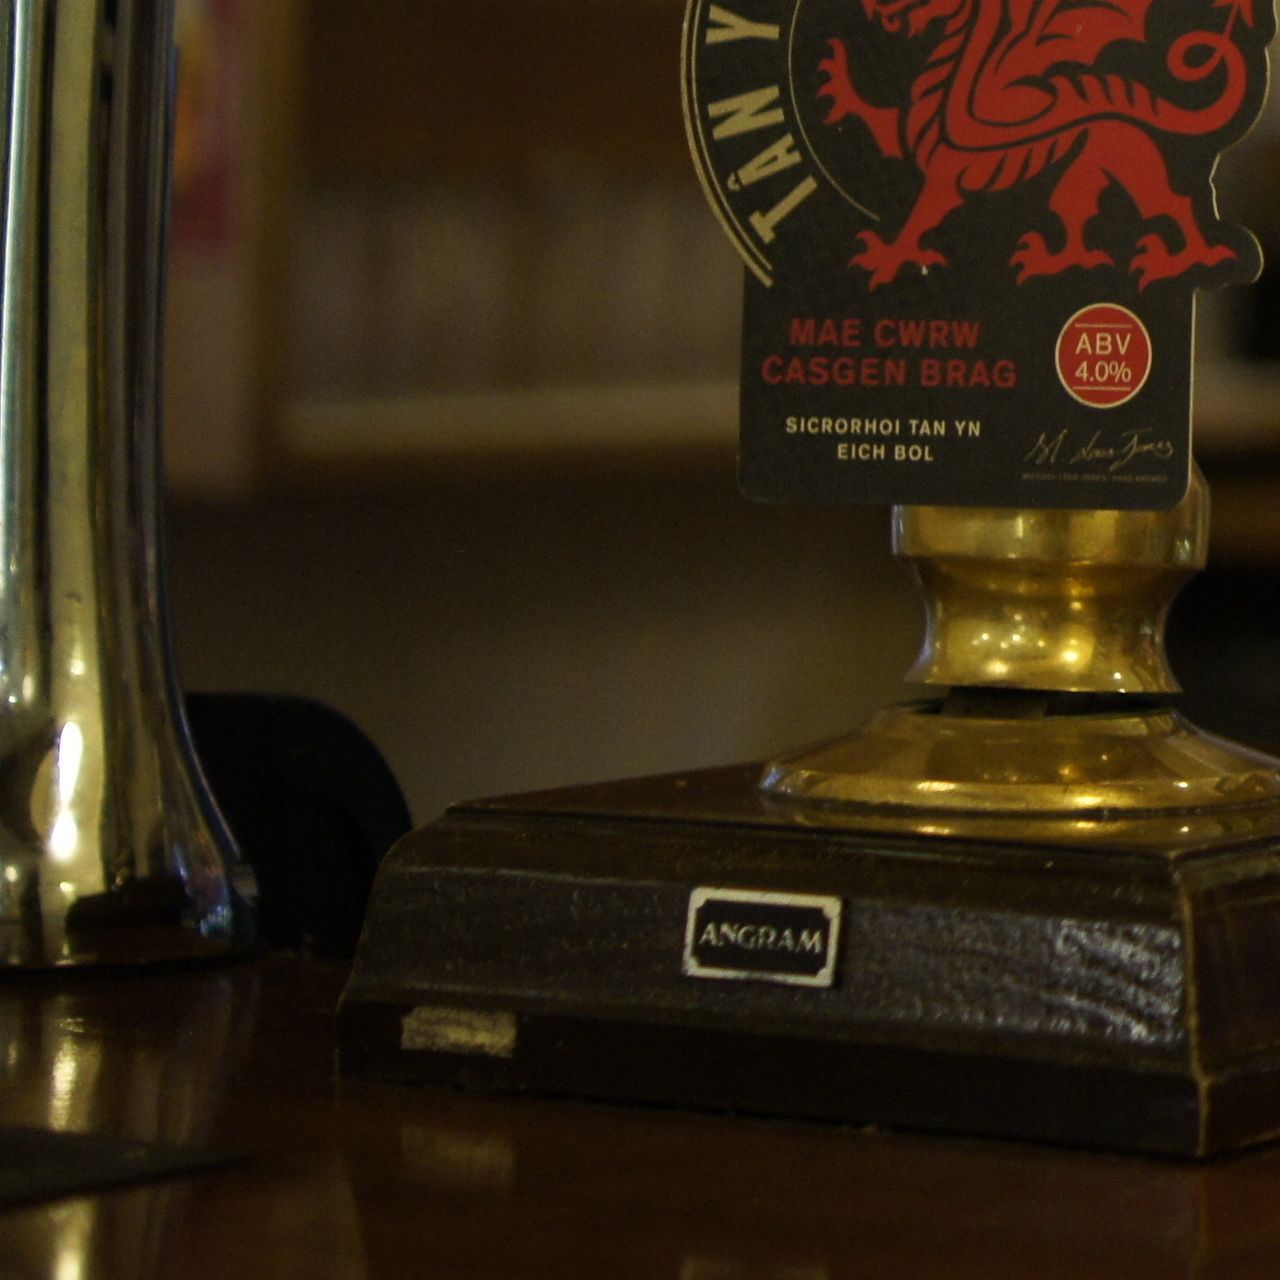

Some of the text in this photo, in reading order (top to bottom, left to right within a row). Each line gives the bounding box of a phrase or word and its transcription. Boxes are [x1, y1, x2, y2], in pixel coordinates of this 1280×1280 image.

[705, 4, 780, 45] Y
[706, 85, 818, 245] TÂN
[790, 318, 982, 349] MAE CWRW
[1075, 332, 1132, 355] ABV
[761, 355, 1019, 388] CASGEN BRAG
[1074, 361, 1132, 384] 4.0%
[785, 416, 982, 437] SICRORHOI TAN YN
[837, 442, 934, 462] EICH BOL
[699, 921, 823, 955] ANGRAM
